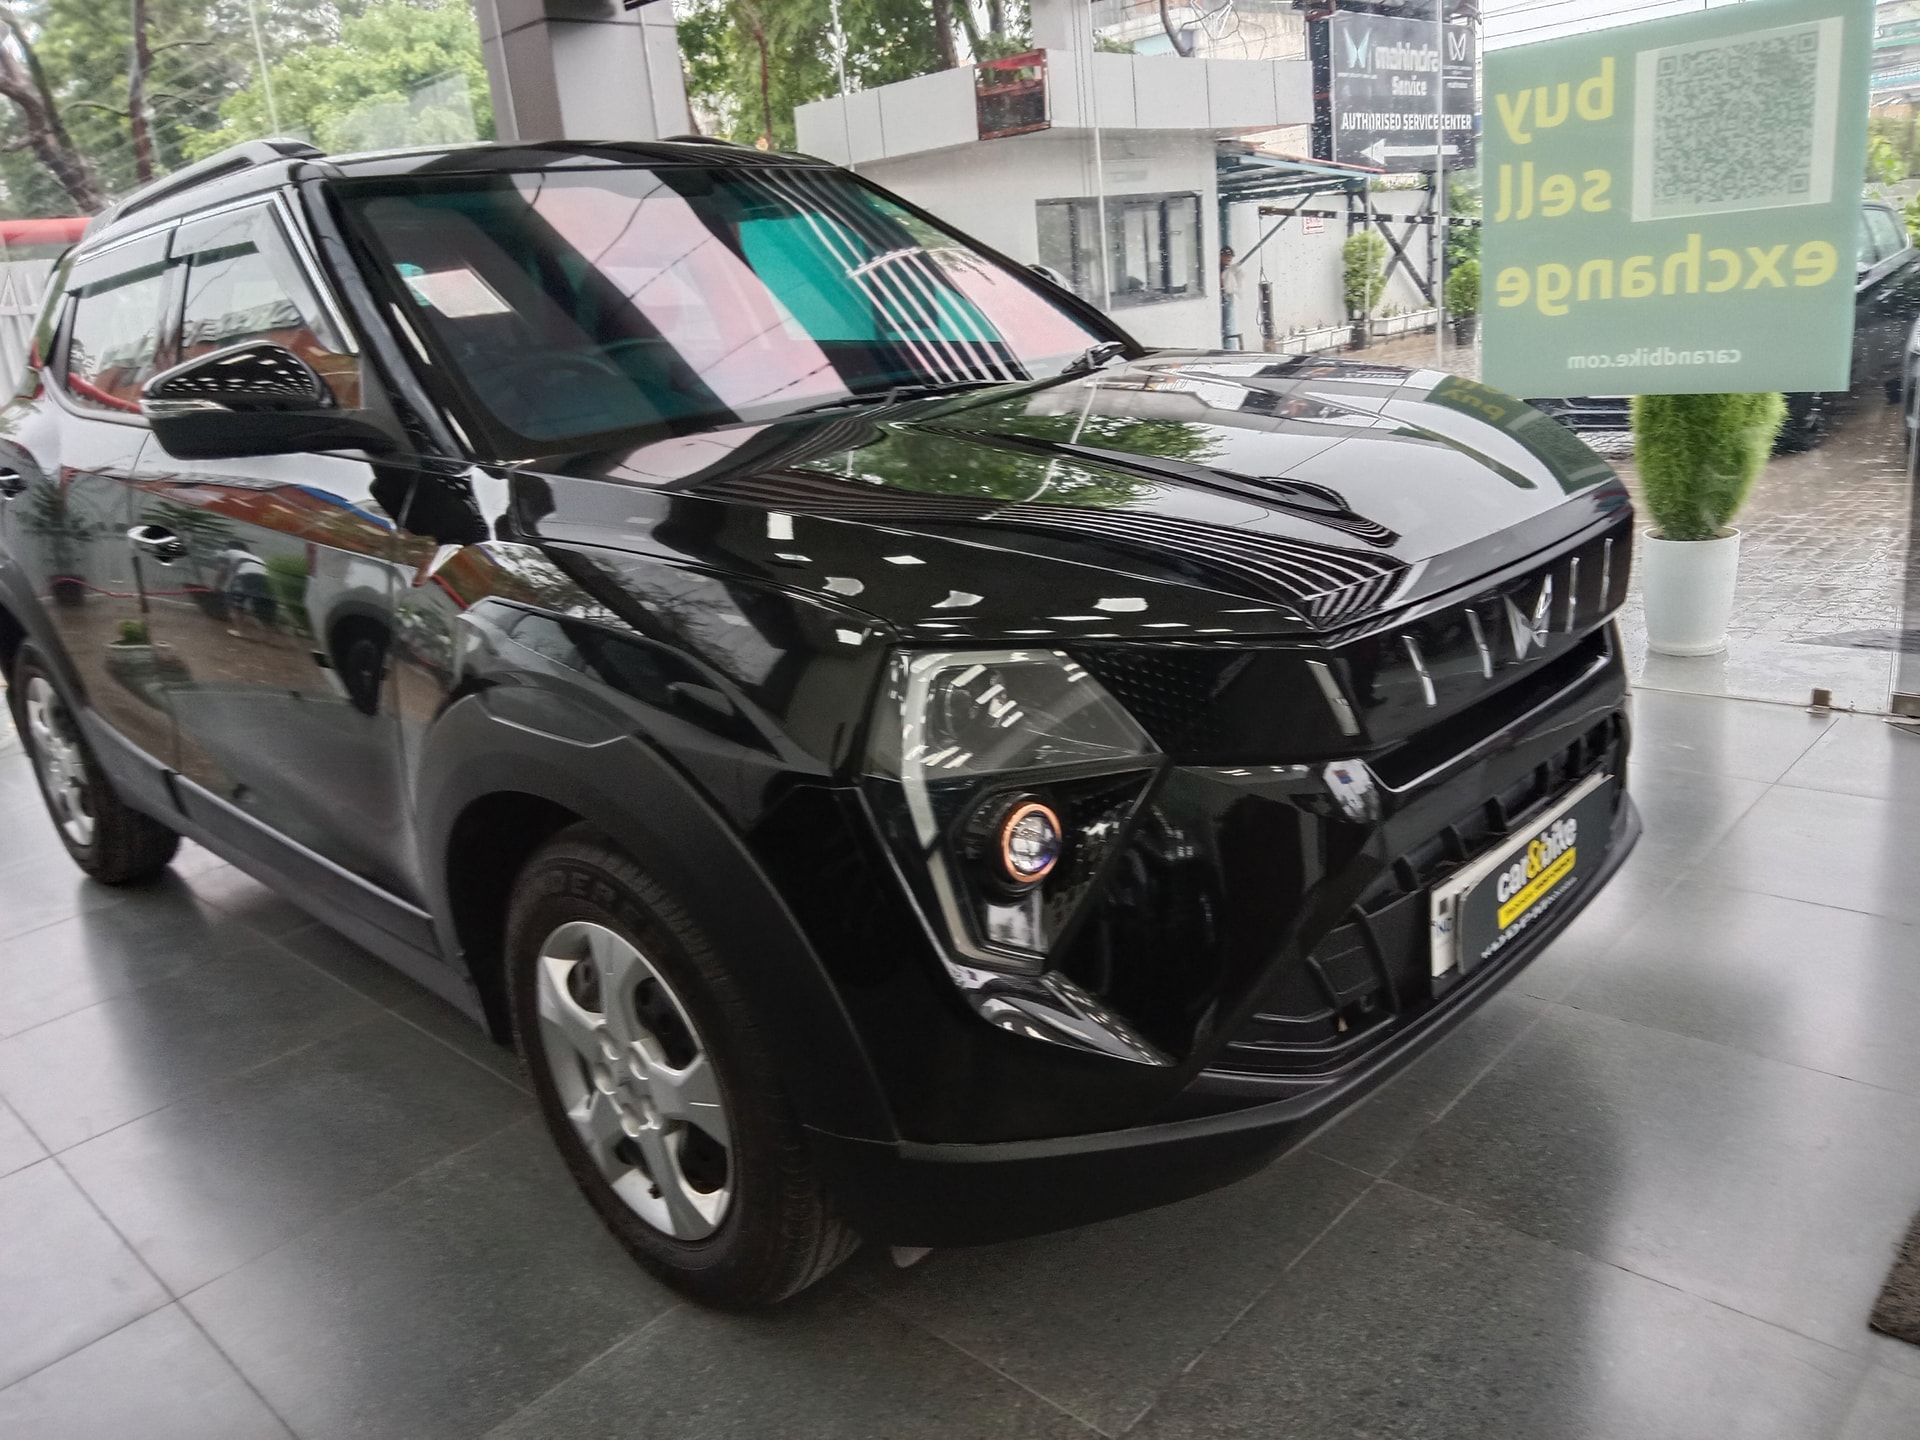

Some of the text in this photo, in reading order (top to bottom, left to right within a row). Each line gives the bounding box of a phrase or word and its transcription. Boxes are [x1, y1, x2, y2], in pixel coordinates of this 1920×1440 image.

[1391, 75, 1427, 96] Service
[1341, 113, 1473, 130] AUTHORISED SERVICE CENTER
